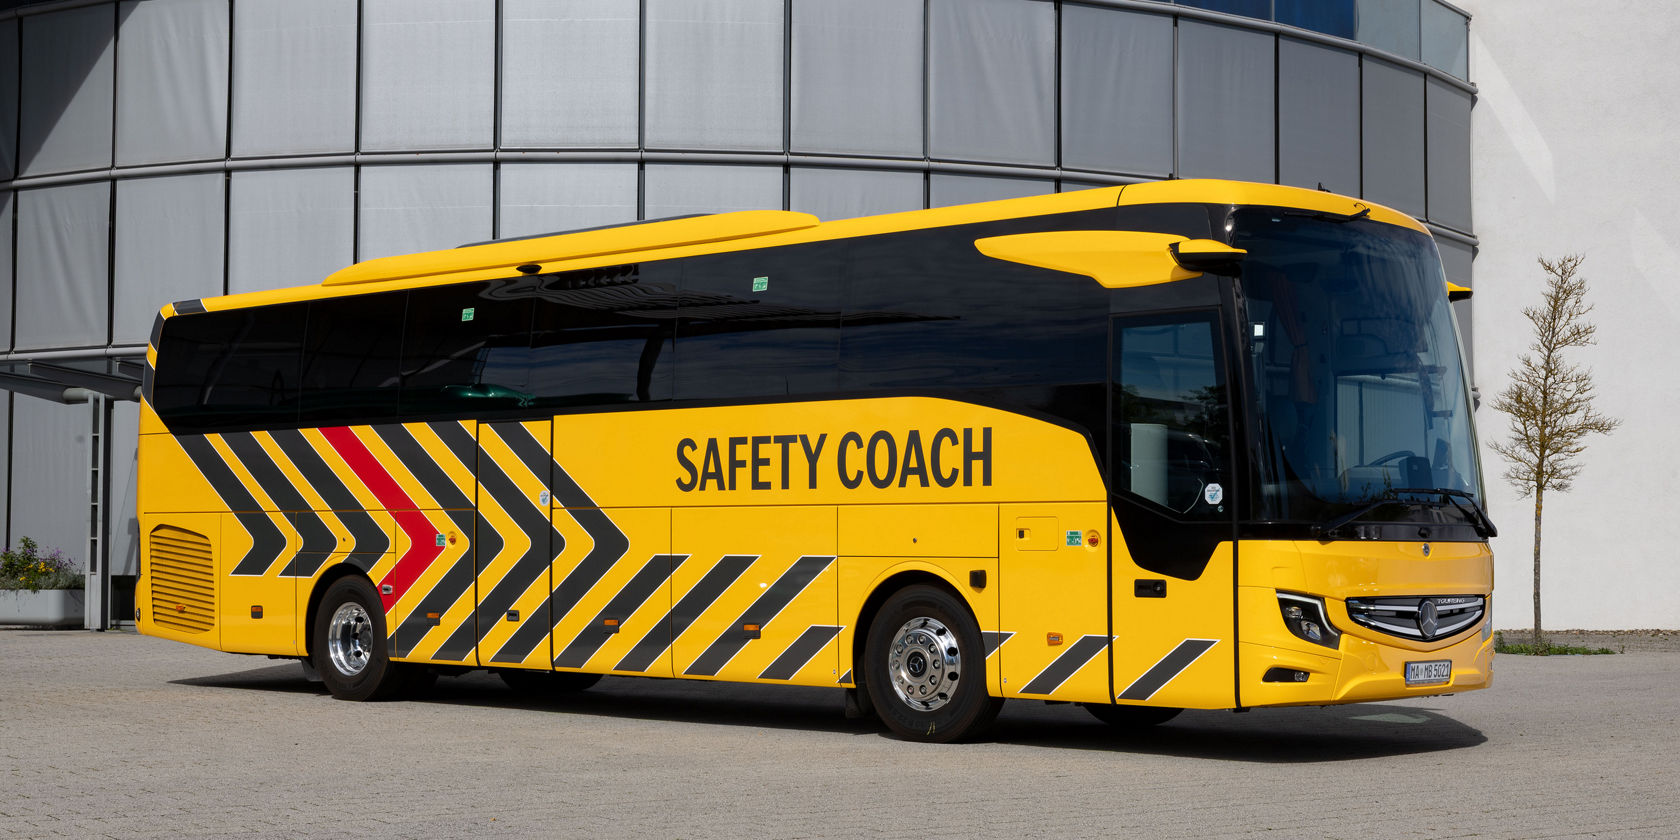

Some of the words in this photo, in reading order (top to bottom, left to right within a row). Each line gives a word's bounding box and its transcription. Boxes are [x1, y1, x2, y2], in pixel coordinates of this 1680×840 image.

[675, 433, 828, 492] SAFETY
[837, 427, 993, 490] COACH
[1410, 664, 1420, 679] MA
[1424, 664, 1433, 678] MB
[1433, 663, 1449, 678] 5021
